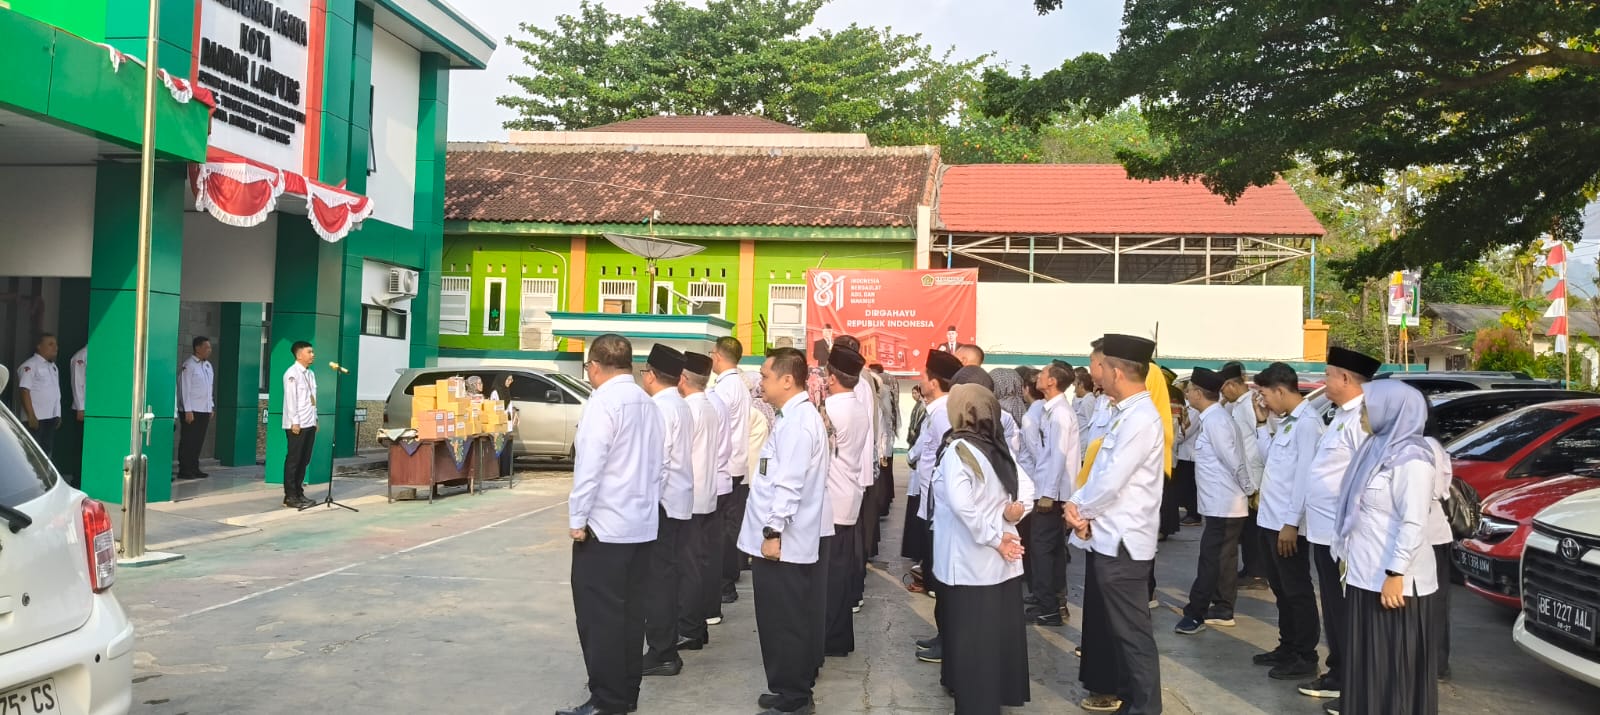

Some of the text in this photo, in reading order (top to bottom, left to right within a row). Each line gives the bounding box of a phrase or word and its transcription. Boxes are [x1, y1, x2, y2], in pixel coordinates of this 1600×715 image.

[240, 22, 271, 62] KOTA
[200, 37, 249, 84] BANDAR
[250, 60, 300, 106] LAMPUNG
[813, 271, 846, 312] 81
[847, 320, 934, 328] REPUBLIK INDONESIA
[865, 309, 916, 317] DIRGAHAYU
[1539, 597, 1592, 632] BE 1227 AAL
[31, 684, 54, 713] CS
